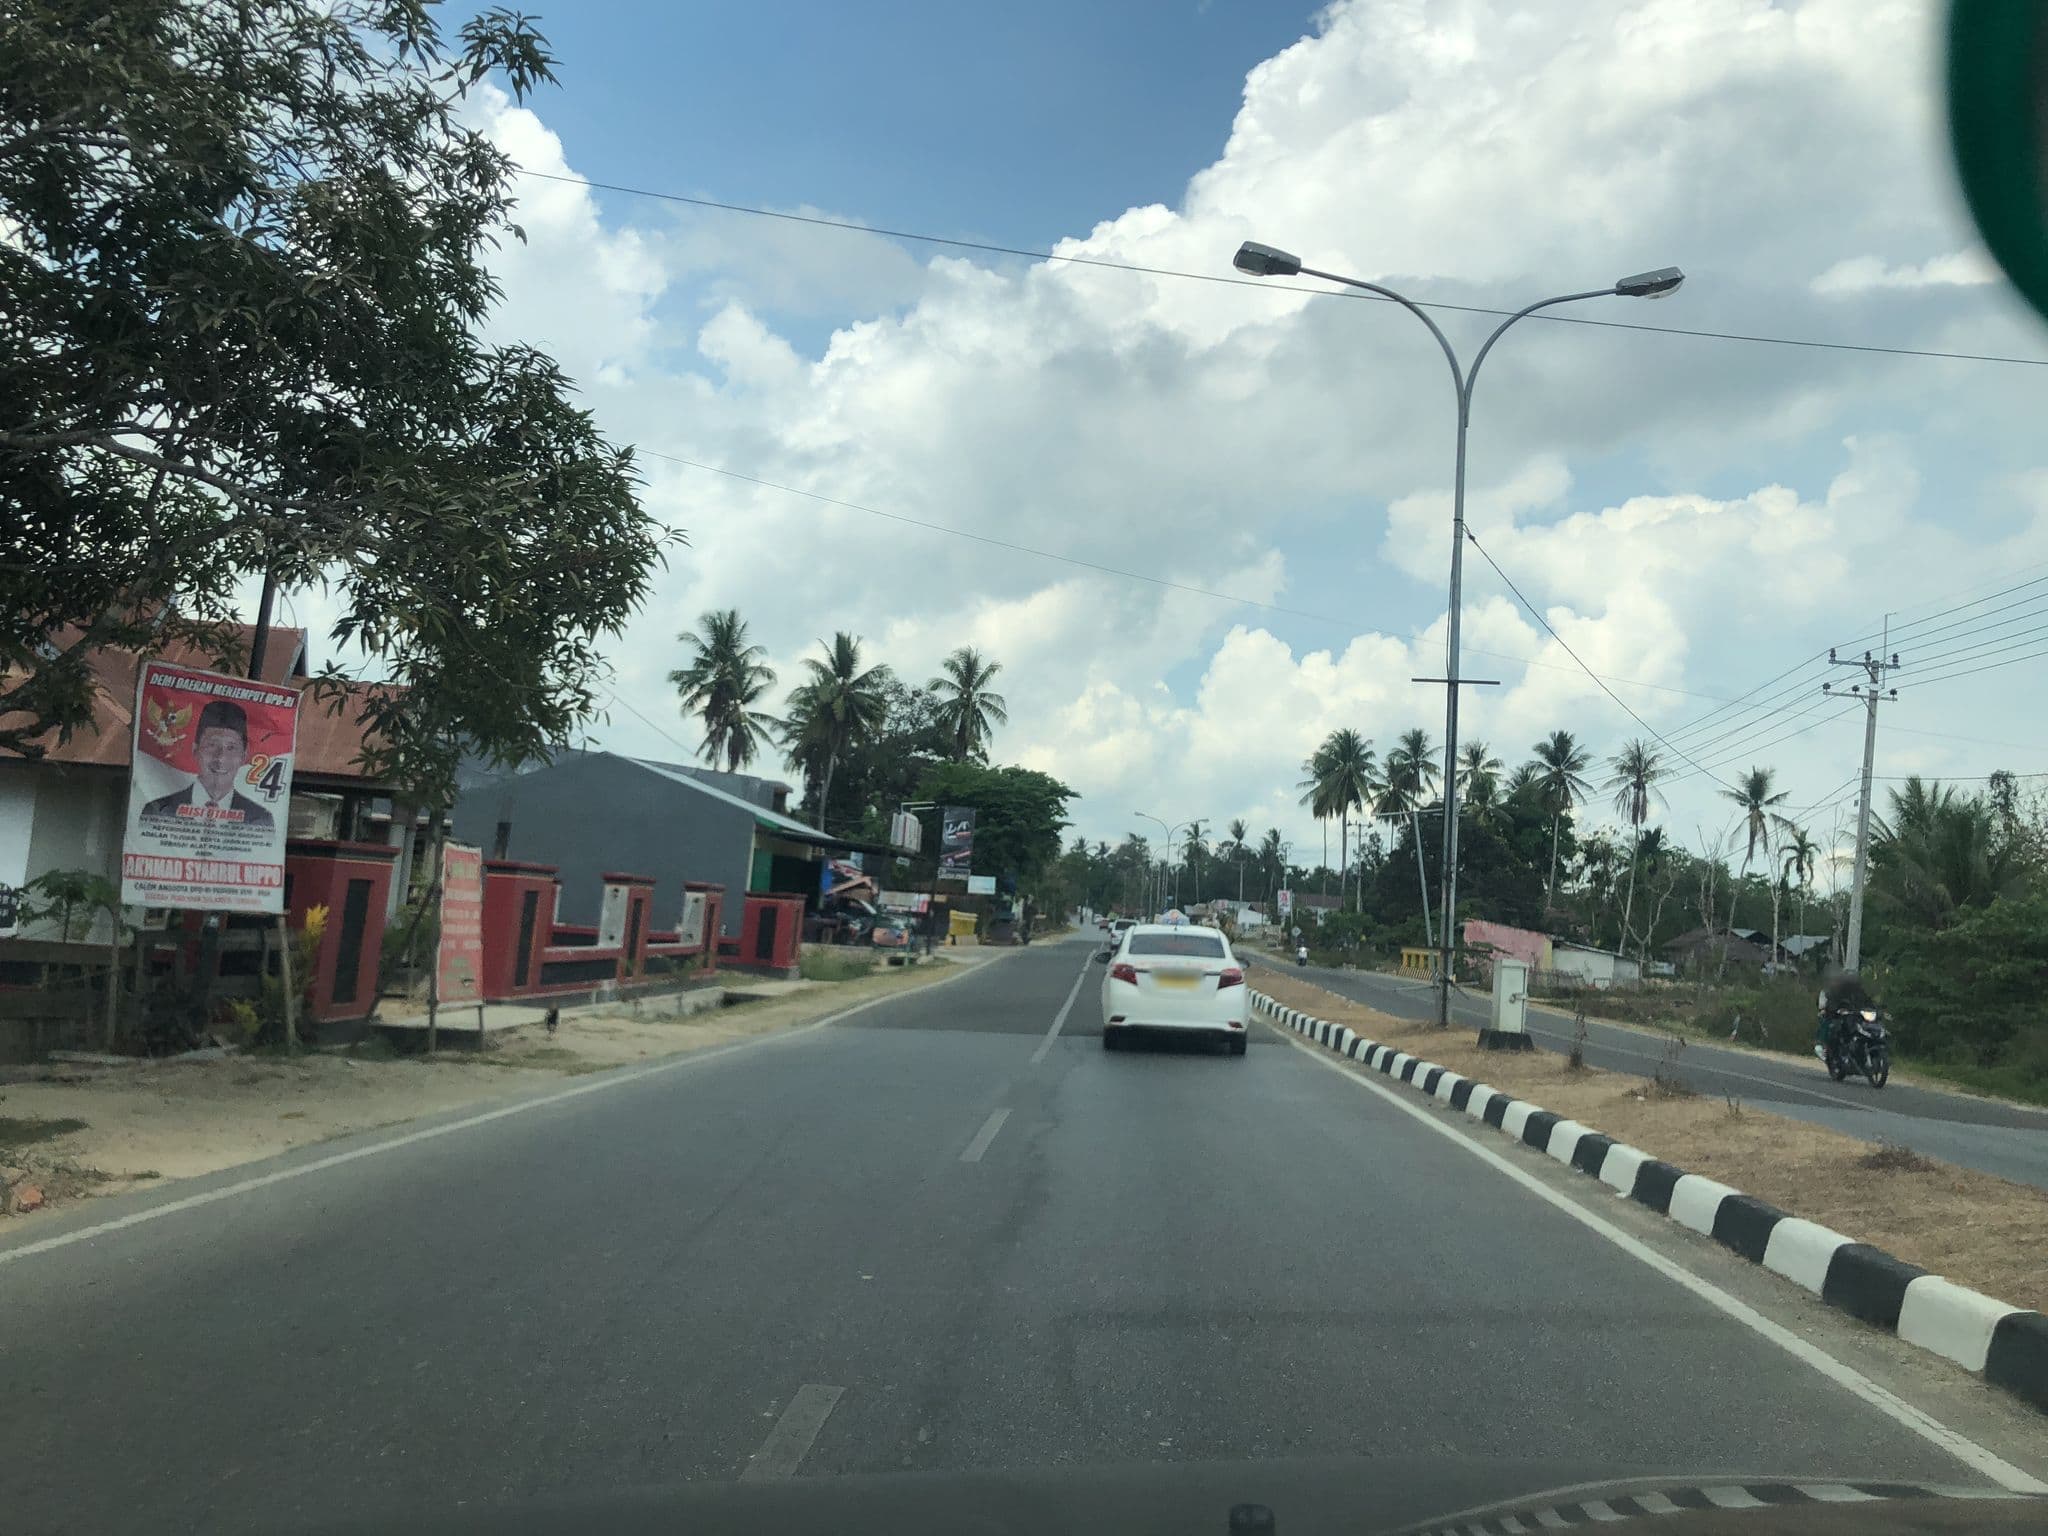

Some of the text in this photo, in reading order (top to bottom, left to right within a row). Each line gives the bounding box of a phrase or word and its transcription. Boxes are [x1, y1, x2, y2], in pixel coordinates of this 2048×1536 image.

[150, 673, 175, 687] DEMI
[175, 678, 214, 693] DAERAH
[213, 684, 266, 702] MENJEMPUT
[246, 753, 287, 802] 24
[177, 805, 245, 821] MISI UTAMA
[134, 882, 157, 891] CALON
